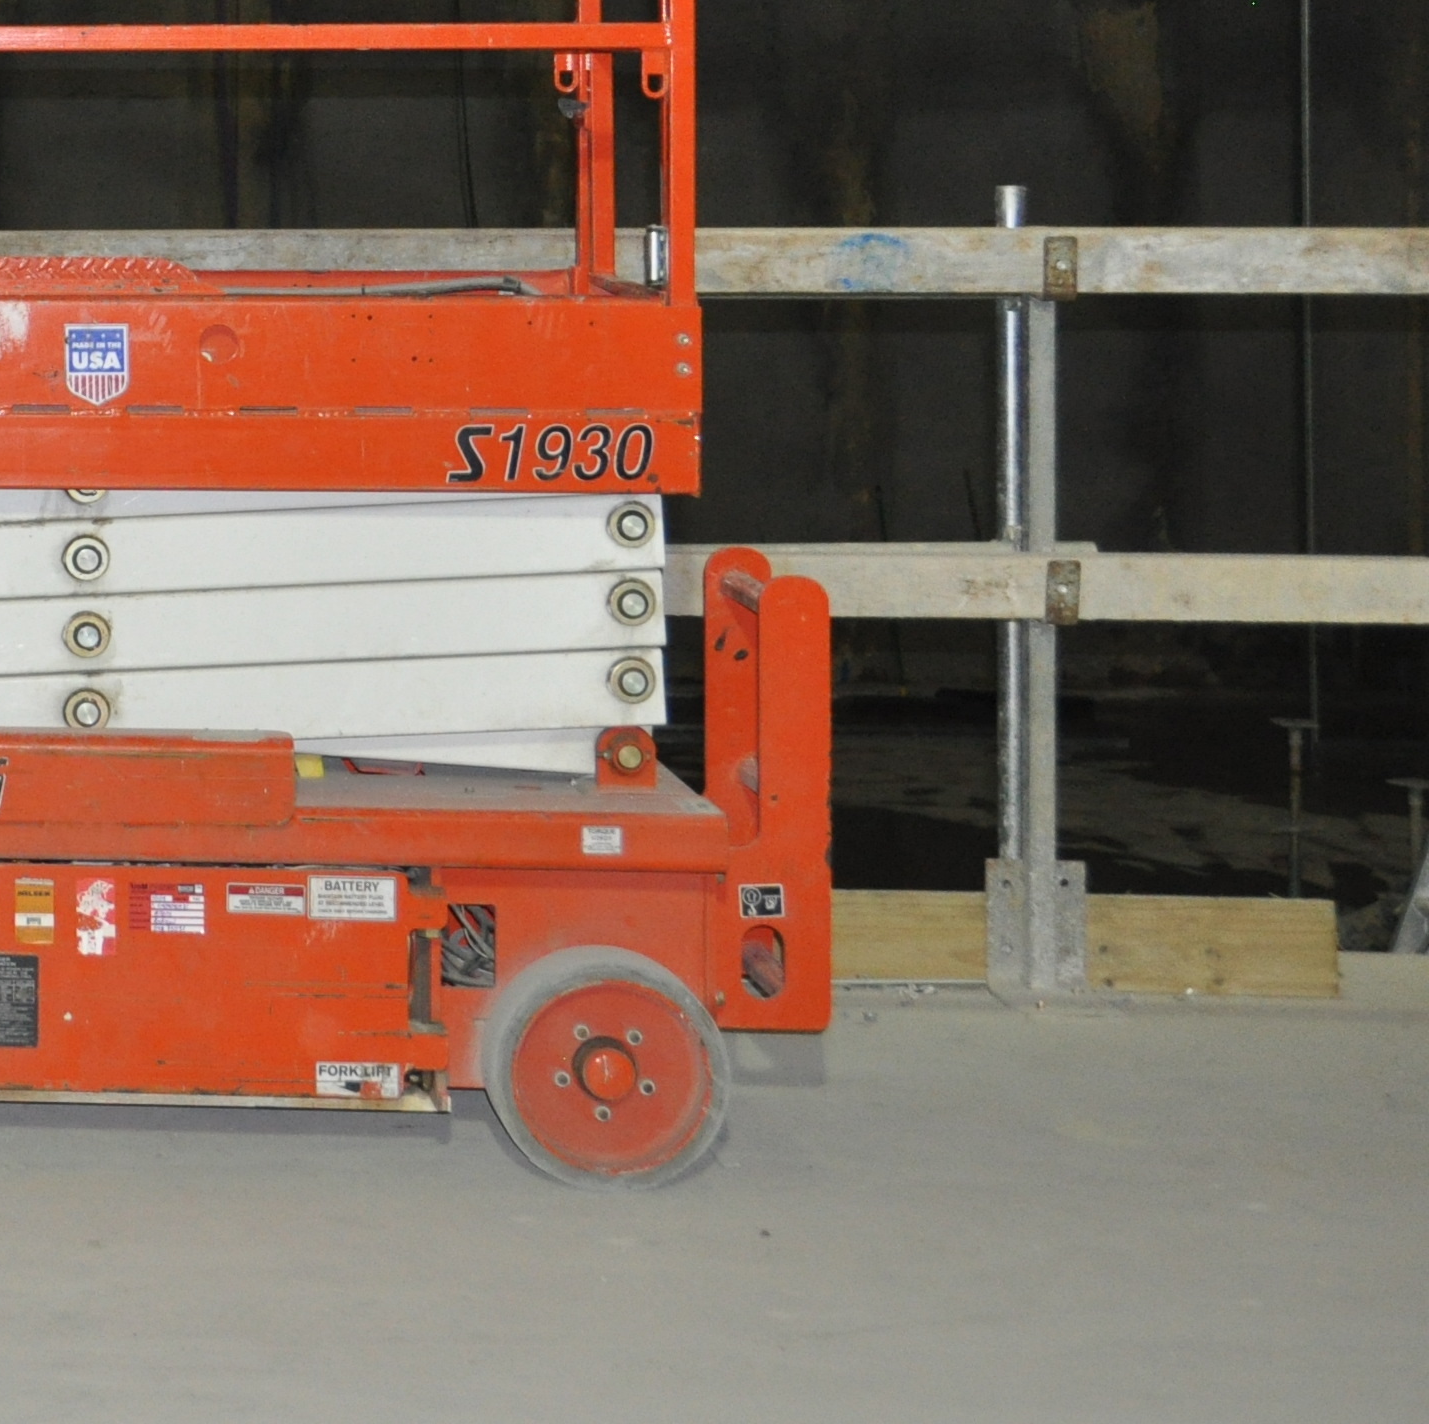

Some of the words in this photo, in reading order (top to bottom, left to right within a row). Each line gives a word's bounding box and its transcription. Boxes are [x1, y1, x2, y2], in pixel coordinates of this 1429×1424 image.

[72, 341, 94, 349] MADE
[71, 351, 121, 370] USA
[446, 422, 654, 484] S1930
[255, 886, 285, 895] DANGER
[324, 880, 380, 893] BATTERY
[318, 1064, 359, 1077] FORK
[364, 1065, 393, 1077] LIFT
